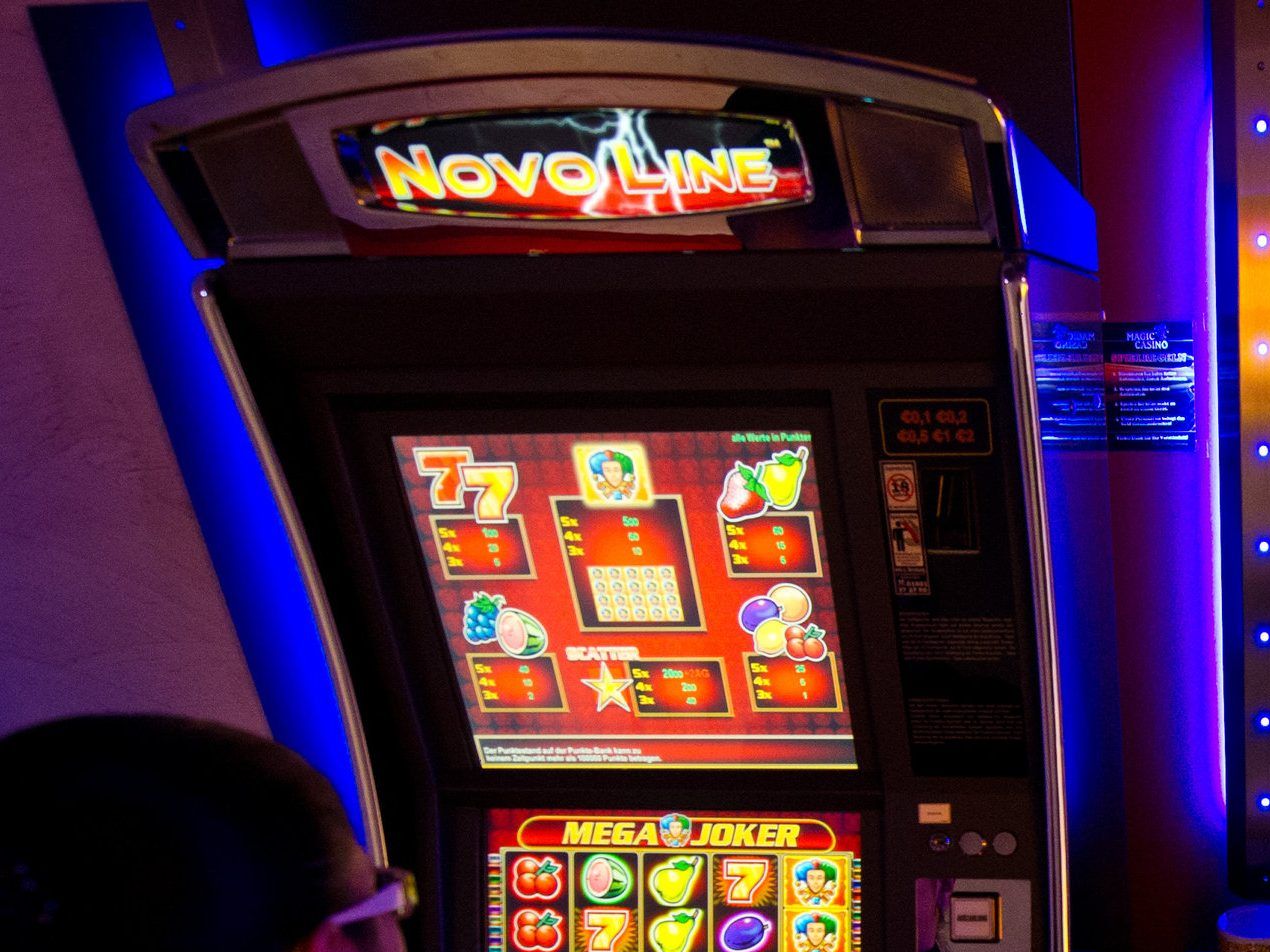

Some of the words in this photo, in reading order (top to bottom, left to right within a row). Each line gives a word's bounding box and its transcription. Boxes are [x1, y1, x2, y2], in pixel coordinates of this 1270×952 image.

[1126, 331, 1155, 341] MAGIC
[1135, 340, 1168, 350] CASINO
[725, 524, 745, 536] 5x
[729, 539, 748, 550] 4x
[732, 553, 749, 565] 3x
[565, 646, 640, 661] SCATTER
[750, 662, 768, 673] 5x
[632, 668, 650, 678] 5x
[753, 676, 771, 686] 4x
[635, 682, 653, 692] 4x
[756, 689, 773, 699] 3x
[638, 695, 656, 705] 3x
[562, 821, 659, 846] MEGA
[690, 822, 800, 848] JOKER
[722, 859, 768, 905] 7
